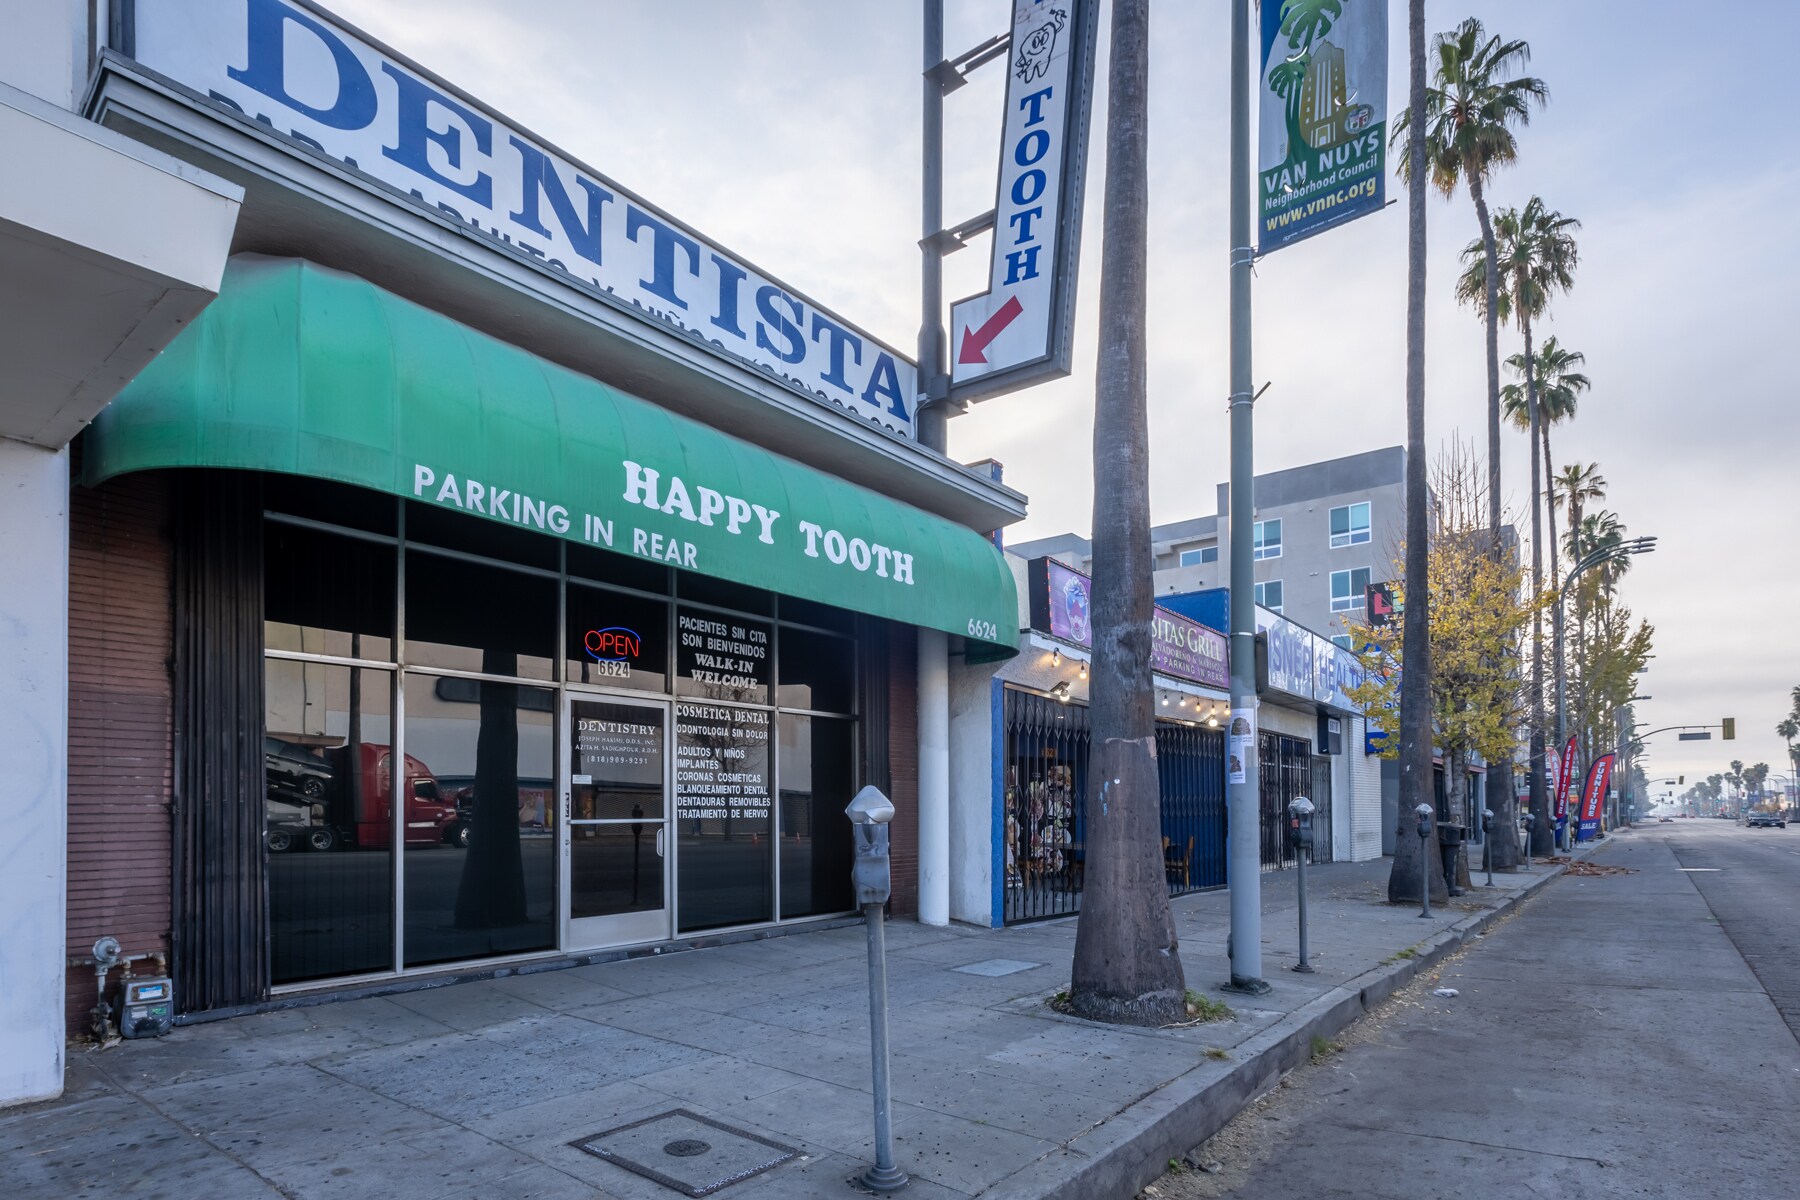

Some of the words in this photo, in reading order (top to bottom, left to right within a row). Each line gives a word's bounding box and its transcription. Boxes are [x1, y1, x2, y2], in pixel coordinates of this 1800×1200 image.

[1265, 161, 1307, 194] VAN
[1319, 130, 1379, 173] NUYS
[1002, 86, 1053, 286] TOOTH
[1265, 172, 1336, 211] Neighborhood
[1338, 153, 1378, 180] Council
[227, 0, 911, 423] DENTISTA
[1266, 176, 1377, 231] www.vnnc.org
[413, 464, 570, 534] PARKING
[584, 513, 614, 547] IN
[633, 528, 699, 569] REAR
[622, 459, 781, 545] HAPPY
[799, 519, 915, 586] TOOTH
[679, 615, 727, 637] PACIENTES
[732, 622, 746, 639] SIN
[750, 627, 767, 644] CITA
[967, 618, 998, 641] 6624
[1152, 615, 1184, 648] SITAS
[1187, 627, 1222, 662] GRILL
[585, 630, 639, 657] OPEN
[682, 633, 703, 648] SON
[707, 637, 765, 659] BIENVENIDOS
[1258, 624, 1312, 680] ISNER
[599, 661, 630, 677] 6624
[695, 653, 754, 674] WALK-IN
[1163, 656, 1195, 674] PARKING
[1198, 668, 1205, 677] IN
[1207, 671, 1224, 682] REAR
[691, 669, 758, 690] WELCOME
[578, 720, 656, 735] DENTISTRY
[676, 704, 731, 721] COSMETICA
[734, 709, 770, 725] DENTAL
[676, 724, 729, 737] ODONTOLOGIA
[732, 728, 744, 738] SIN
[746, 729, 768, 740] DOLOR
[677, 746, 711, 757] ADULTOS
[715, 748, 720, 757] Y
[724, 747, 745, 759] NIÑOS
[677, 759, 719, 770] IMPLANTES
[677, 771, 714, 782] CORONAS
[717, 773, 761, 784] COSMETICAS
[677, 784, 741, 795] BLANQUEAMIENTO
[743, 785, 768, 795] DENTAL
[1558, 745, 1572, 814] FURNITURE
[1588, 761, 1606, 817] FURNITURE
[677, 797, 726, 807] DENTADURAS
[729, 797, 771, 807] REMOVIBLES
[677, 809, 727, 819] TRATAMIENTO
[731, 809, 741, 818] DE
[743, 809, 768, 819] NERVIO
[1580, 822, 1597, 830] SALE
